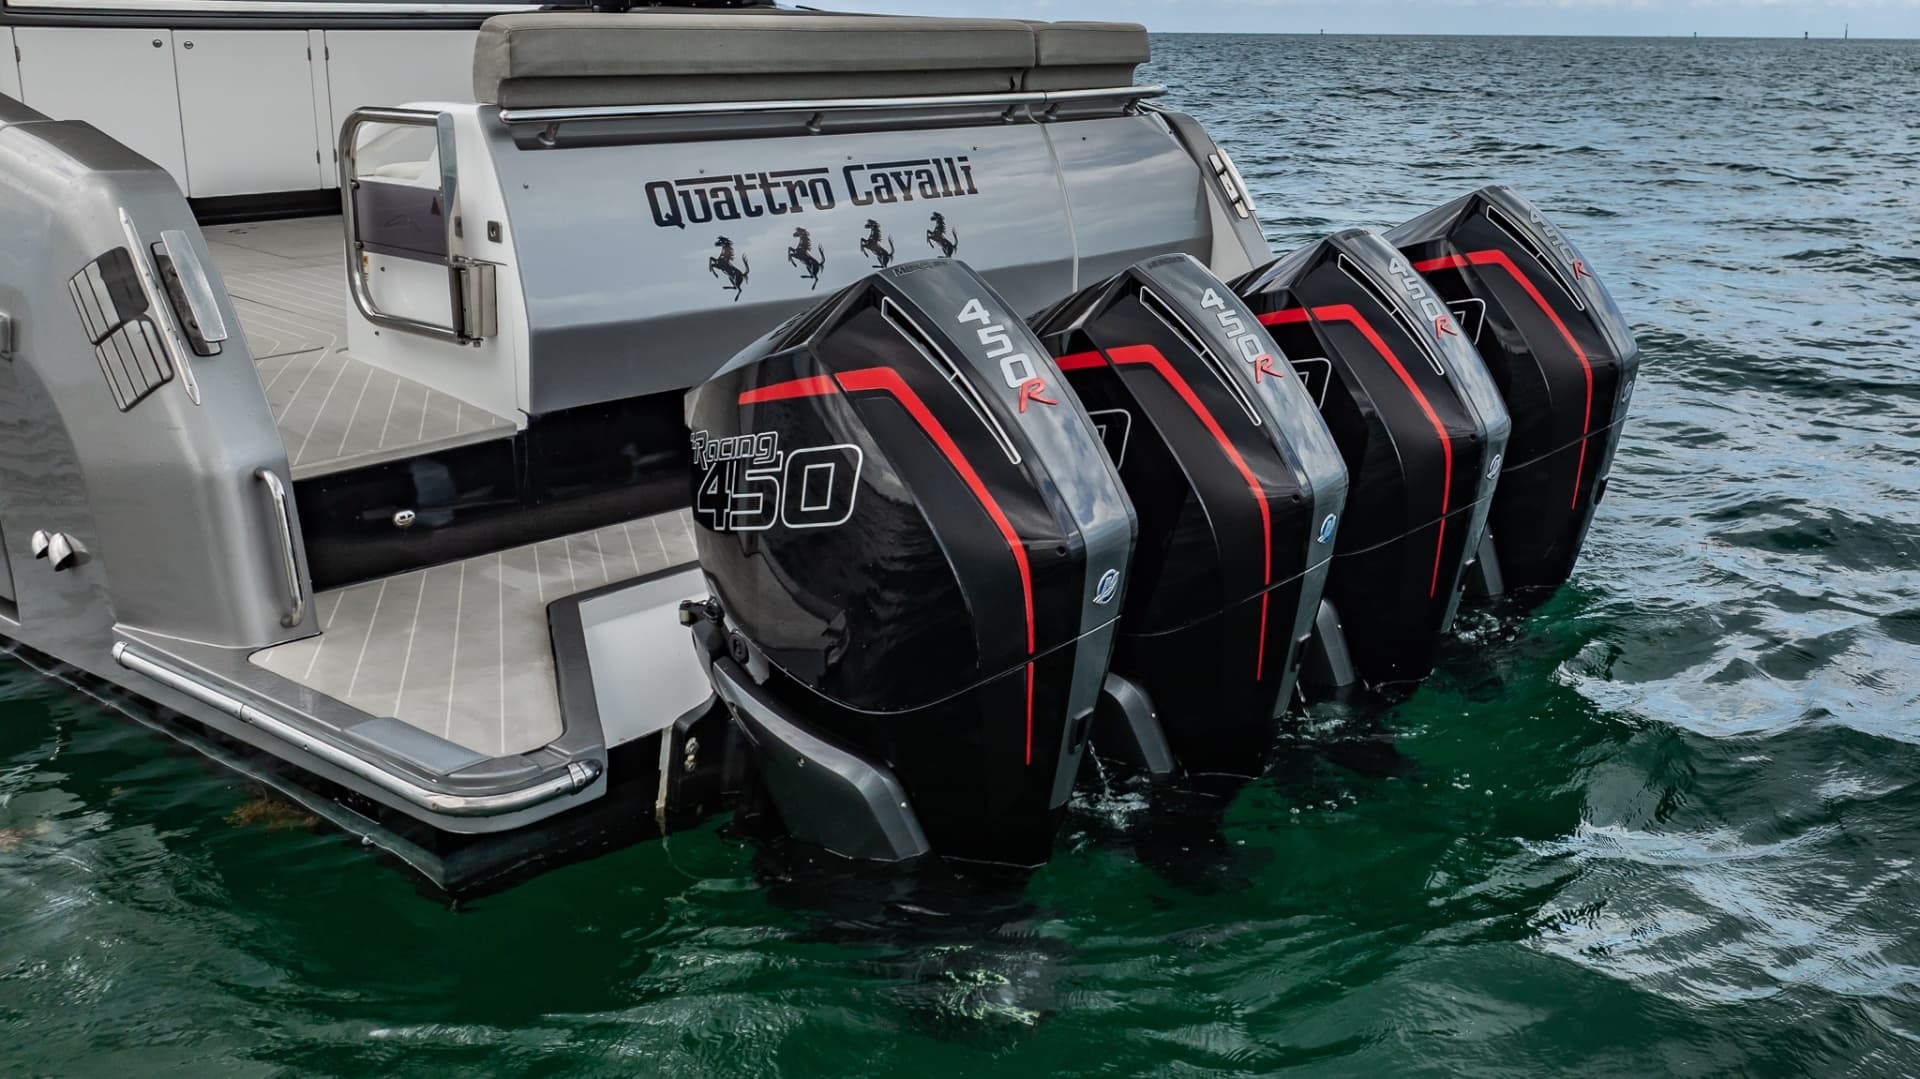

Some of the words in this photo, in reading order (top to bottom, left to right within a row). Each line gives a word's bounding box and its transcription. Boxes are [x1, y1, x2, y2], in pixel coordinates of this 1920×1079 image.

[645, 167, 836, 229] Quattro
[842, 156, 979, 206] Cavalli
[690, 430, 779, 471] Racing
[697, 443, 863, 531] 450
